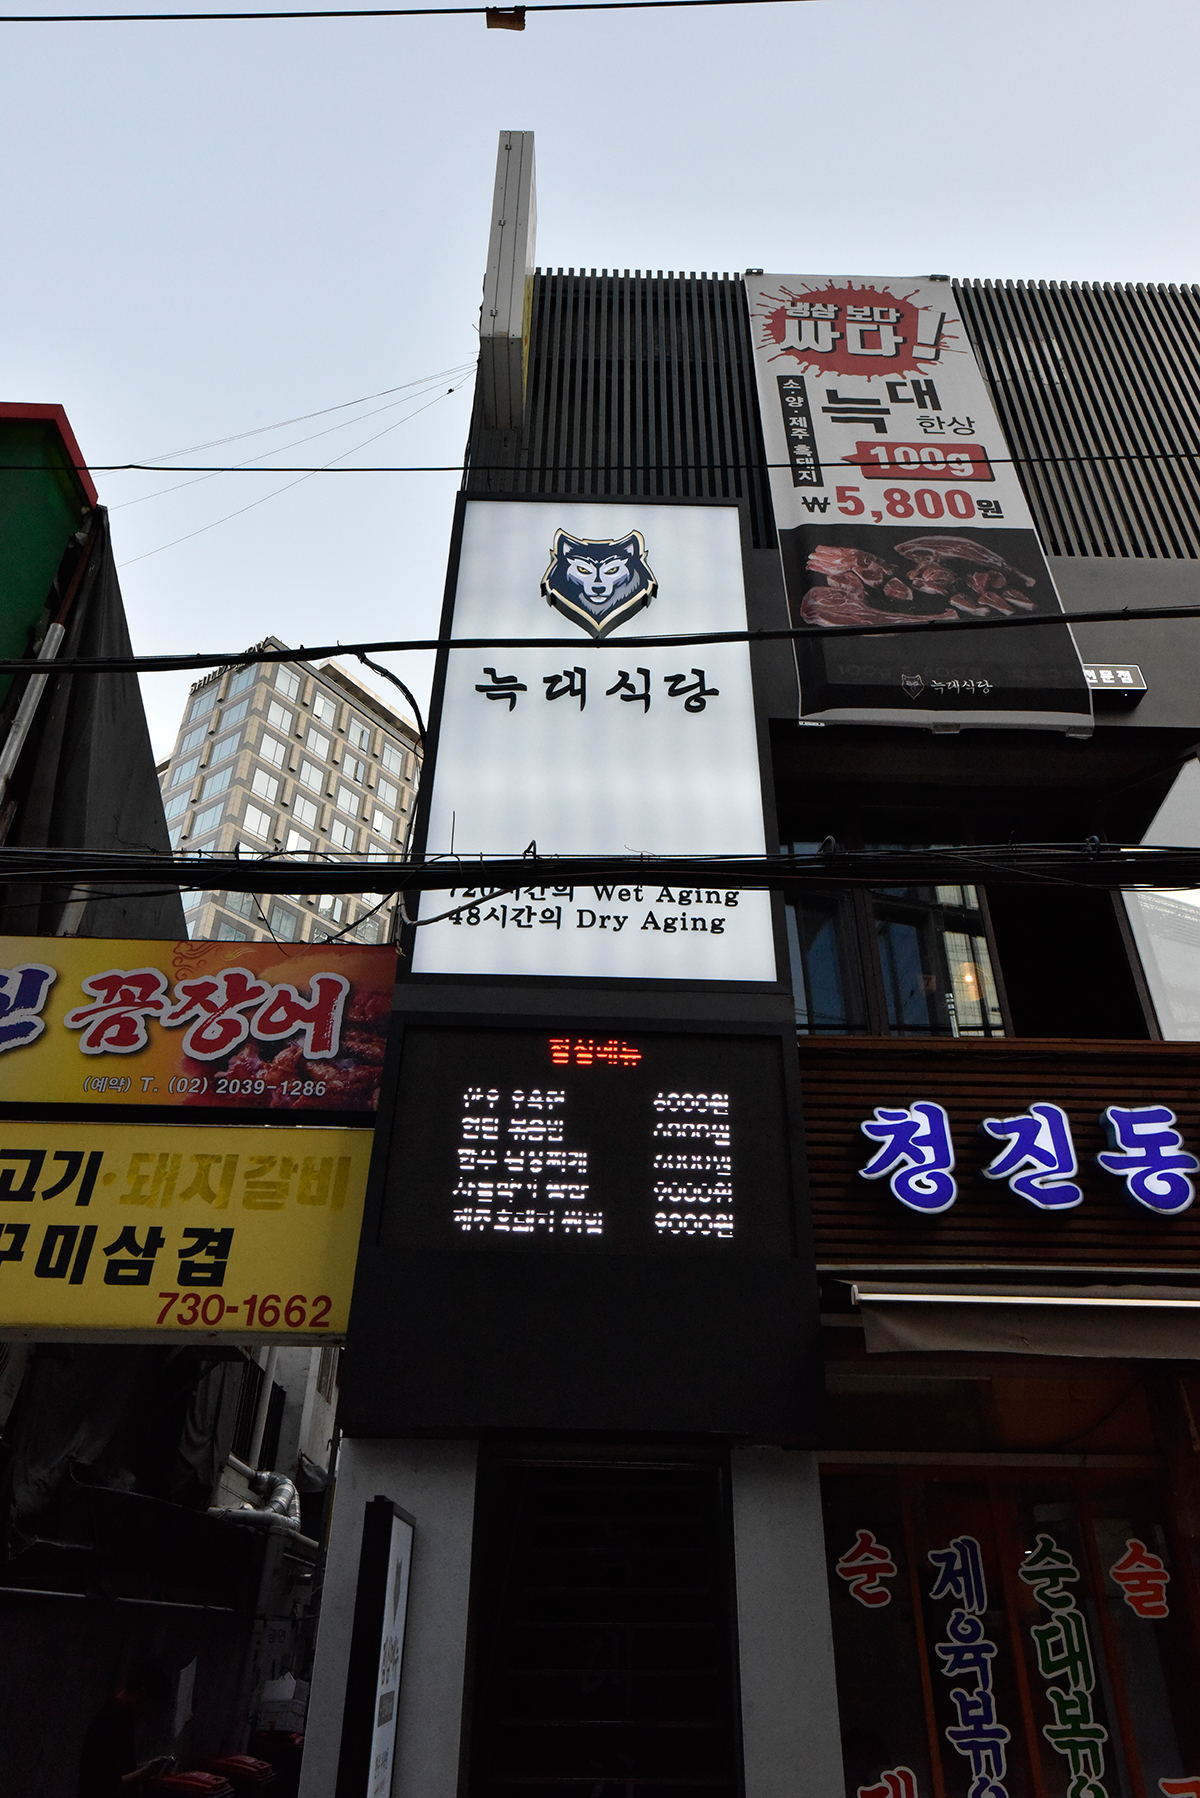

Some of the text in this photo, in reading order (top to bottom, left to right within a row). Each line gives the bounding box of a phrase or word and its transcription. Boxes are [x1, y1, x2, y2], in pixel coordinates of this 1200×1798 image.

[846, 304, 904, 323] 보다
[821, 378, 942, 434] 늑대
[915, 415, 976, 436] 한상
[870, 445, 975, 477] 100g
[475, 666, 720, 714] 늑대식당
[930, 679, 994, 695] 늑대식당
[593, 885, 643, 902] Wet
[655, 886, 740, 907] Aging
[448, 904, 726, 934] 48시간의 Dry Aging
[83, 1076, 327, 1097] (예약) T. (02) 2039-1286
[857, 1099, 1199, 1215] 청진동
[156, 1292, 333, 1329] 730-1662
